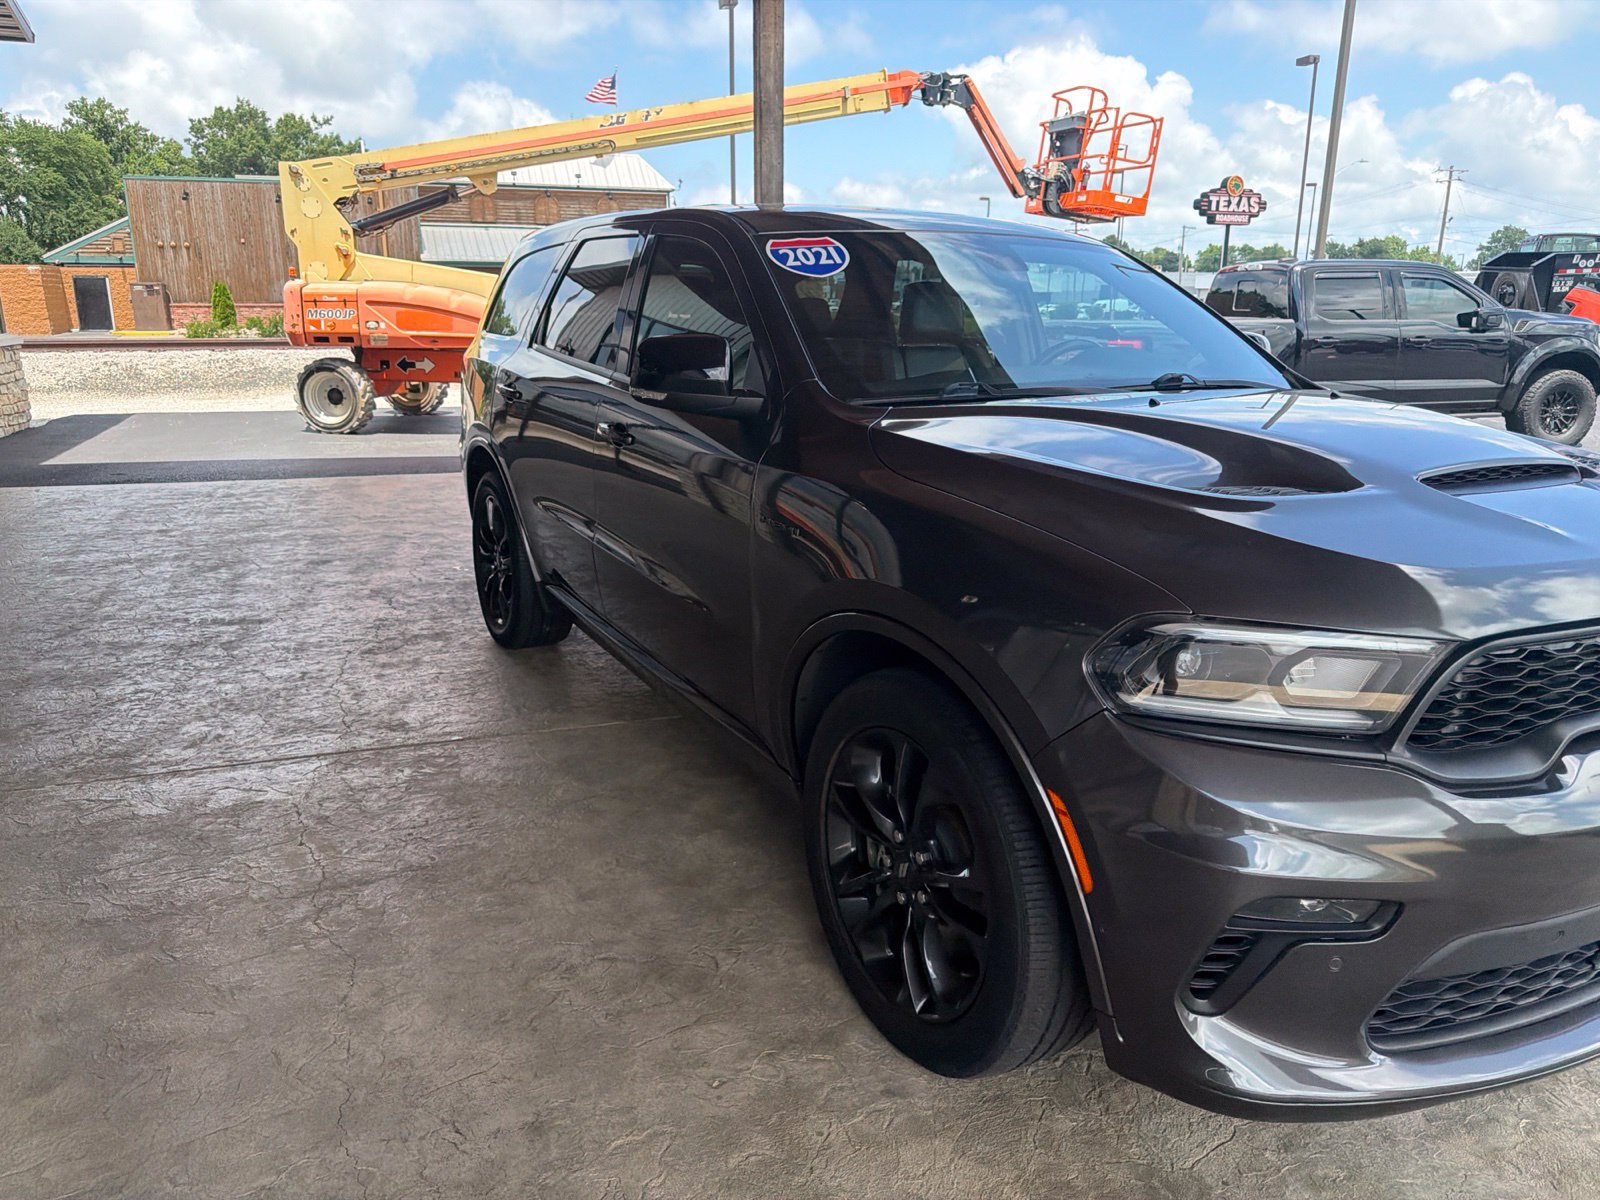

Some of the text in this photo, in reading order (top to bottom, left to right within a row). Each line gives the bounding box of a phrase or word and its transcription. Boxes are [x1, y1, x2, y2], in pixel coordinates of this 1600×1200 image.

[1209, 195, 1260, 213] TEXAS
[1215, 214, 1250, 223] ROADHOUSE
[778, 246, 843, 267] 2021
[307, 308, 356, 320] M600JP
